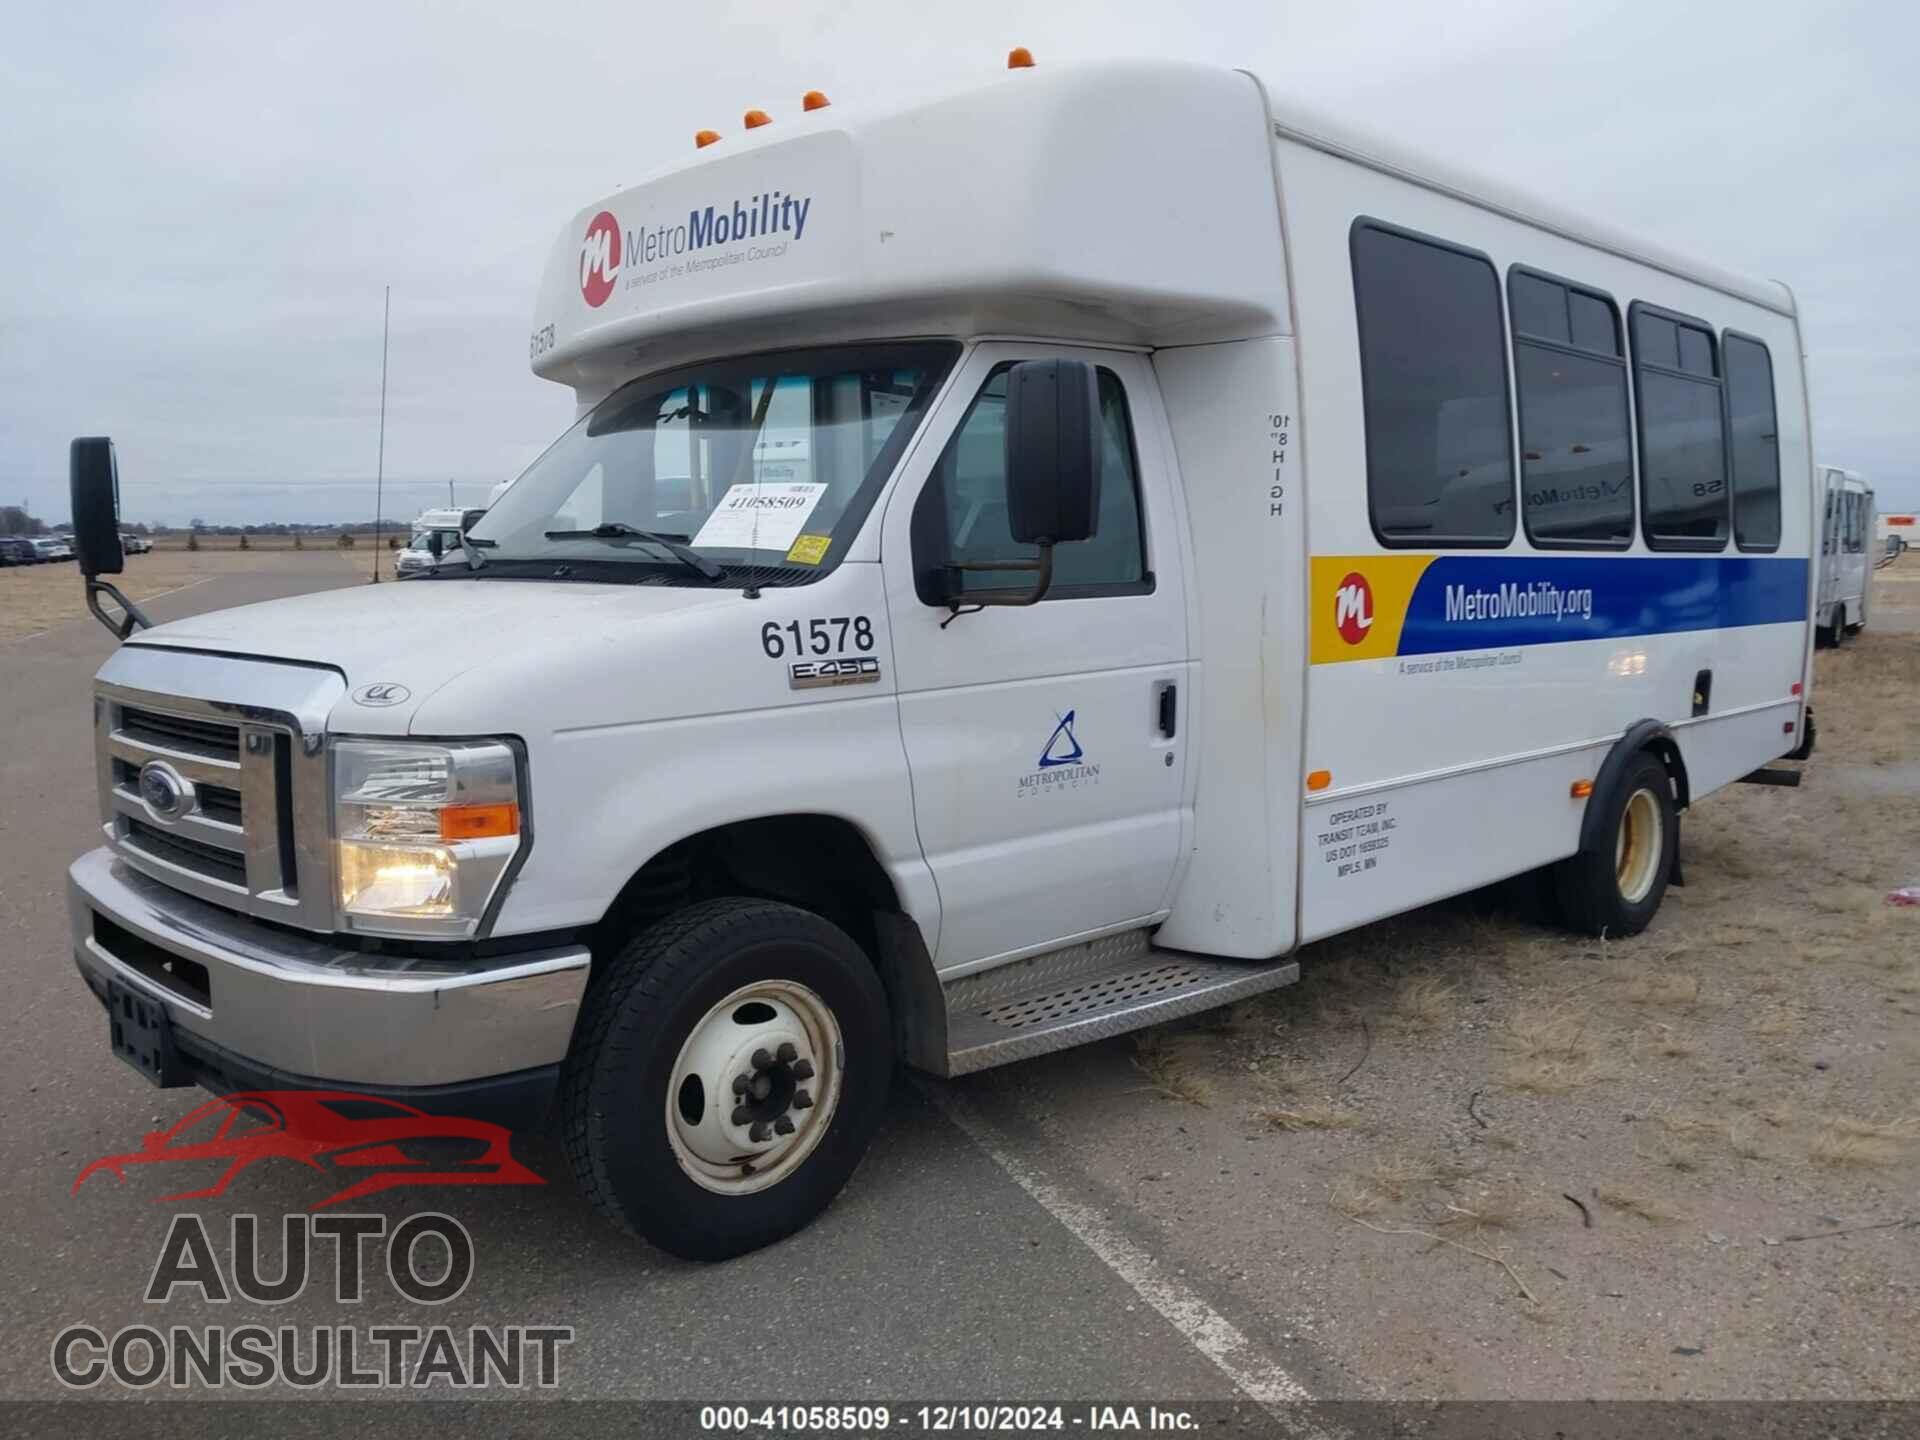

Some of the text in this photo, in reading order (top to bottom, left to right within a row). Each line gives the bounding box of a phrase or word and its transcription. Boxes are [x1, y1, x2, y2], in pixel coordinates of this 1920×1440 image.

[625, 191, 811, 268] MetroMobility
[659, 265, 669, 280] of
[670, 265, 684, 278] the
[686, 251, 745, 273] Metropolitan
[747, 242, 788, 262] Council
[728, 496, 807, 508] 41058509
[1446, 582, 1592, 622] MetroMobility.org
[762, 616, 874, 658] 61578
[1019, 765, 1099, 787] METROPOLITAN
[1329, 803, 1388, 825] OPERATED BY
[1318, 827, 1354, 846] TRANSIT
[1326, 849, 1338, 863] US
[1339, 844, 1356, 859] DOT
